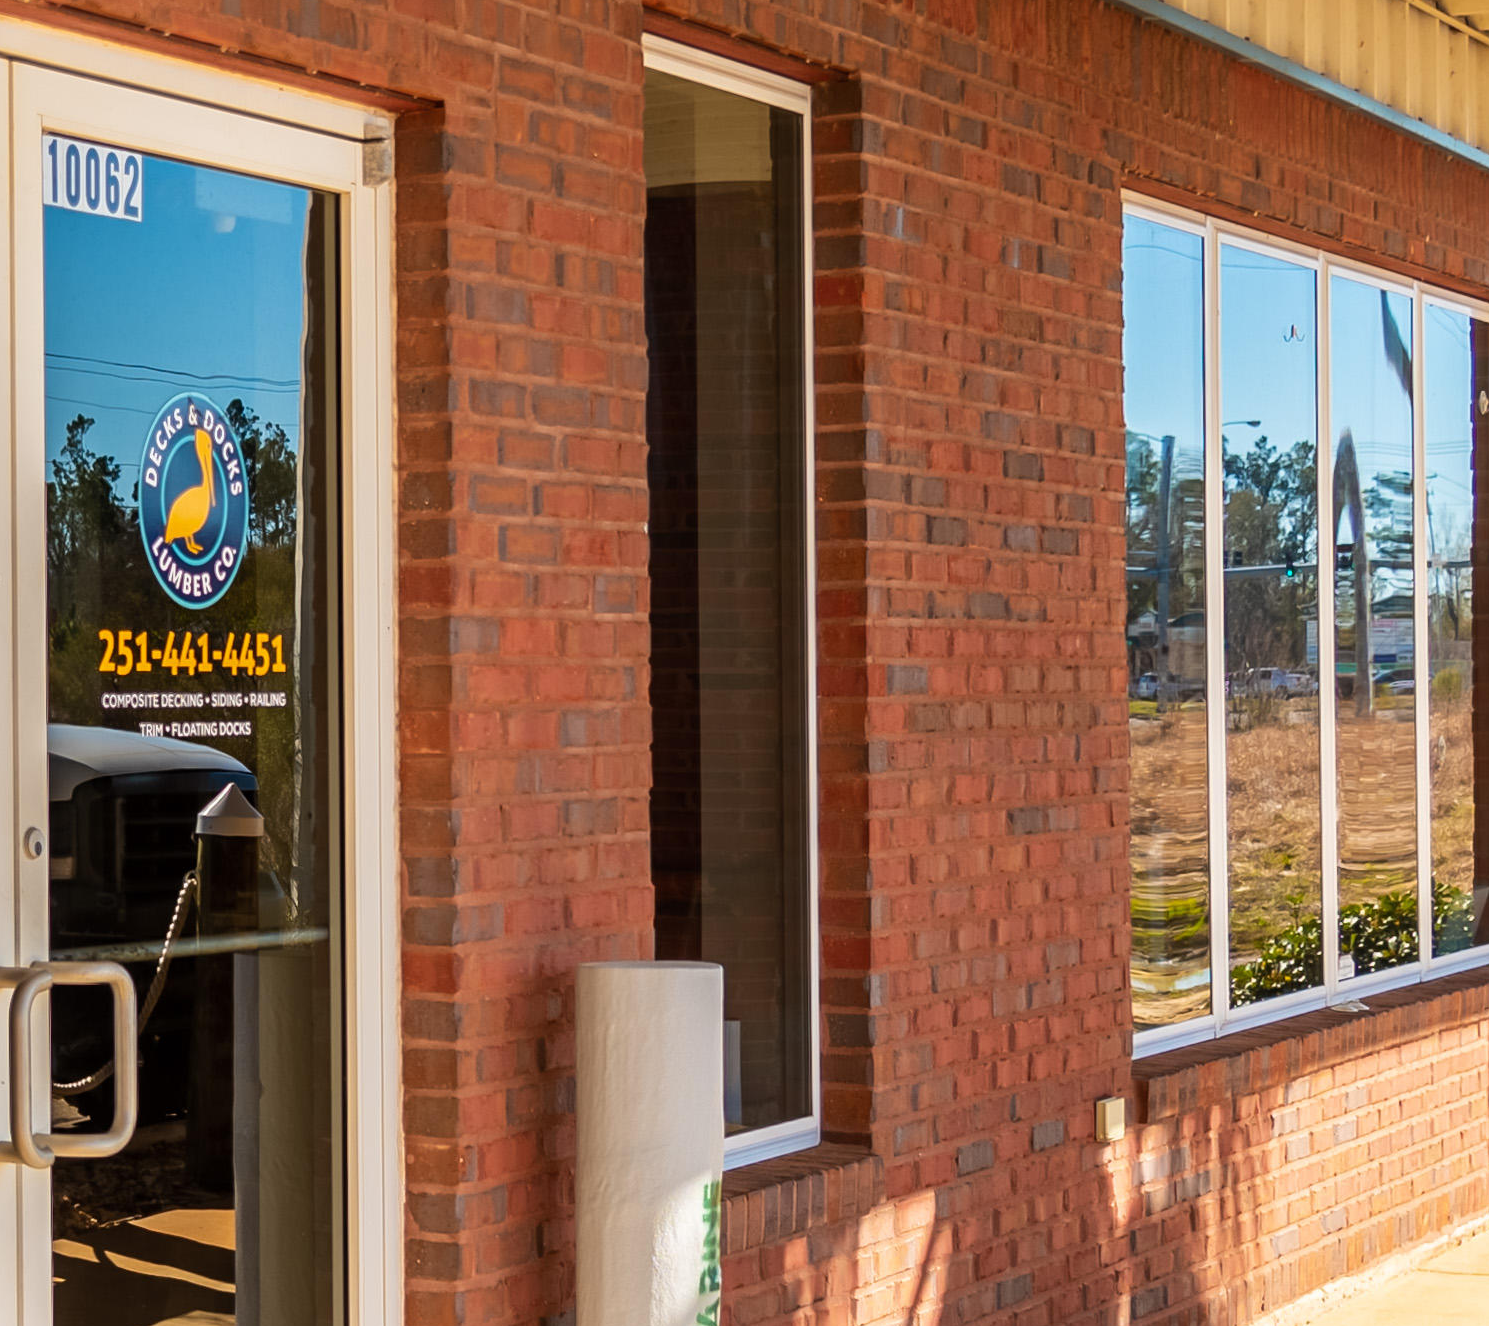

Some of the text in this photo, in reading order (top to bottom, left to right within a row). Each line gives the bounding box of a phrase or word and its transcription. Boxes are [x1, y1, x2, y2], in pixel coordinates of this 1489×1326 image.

[48, 138, 140, 218] 10062
[145, 404, 242, 496] DECKS & DOCKS
[152, 536, 237, 597] LUMBER CO.
[97, 628, 287, 676] 251-441-4451
[102, 692, 286, 709] COMPOSITE DECKING SIDING RAILING
[139, 721, 251, 737] TRIM FLOATING DOCKS
